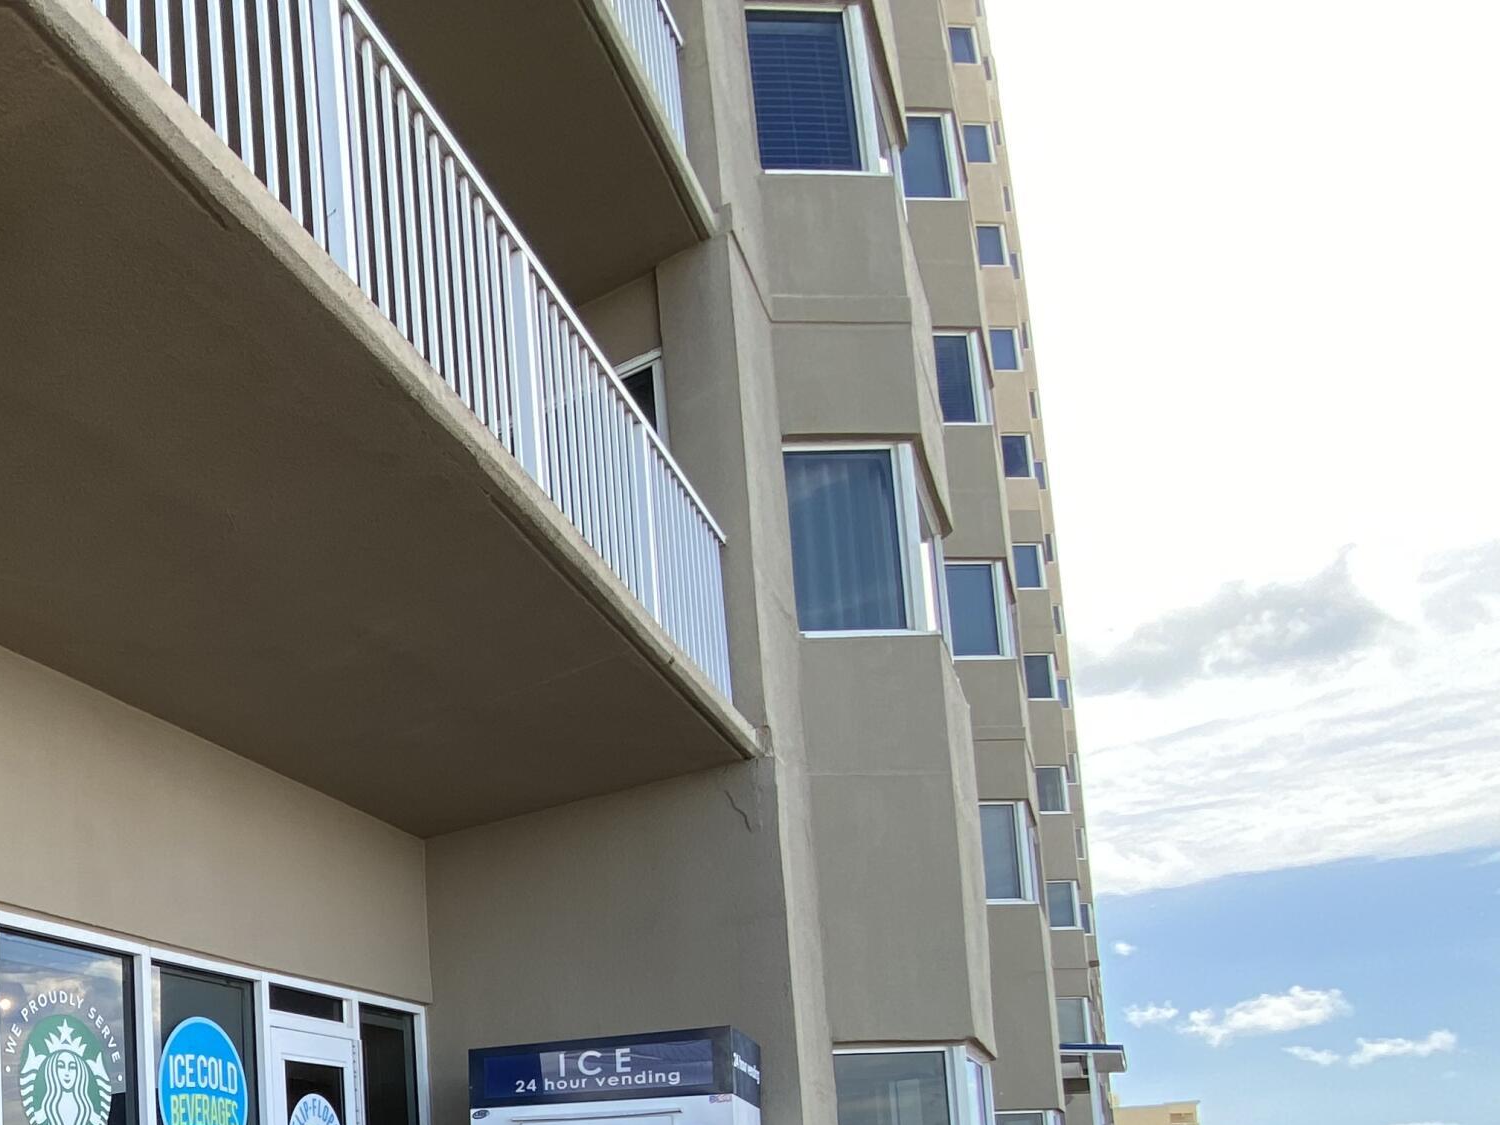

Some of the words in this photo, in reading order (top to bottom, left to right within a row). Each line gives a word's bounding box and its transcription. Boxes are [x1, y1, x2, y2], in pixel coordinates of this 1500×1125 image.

[5, 1023, 22, 1055] WE
[20, 991, 85, 1022] PROUDLY
[87, 1007, 121, 1063] SERVE
[169, 1054, 195, 1089] ICE
[197, 1055, 238, 1095] COLD
[559, 1048, 631, 1077] ICE
[515, 1080, 536, 1093] 24
[544, 1077, 587, 1091] hour
[595, 1069, 681, 1086] vending
